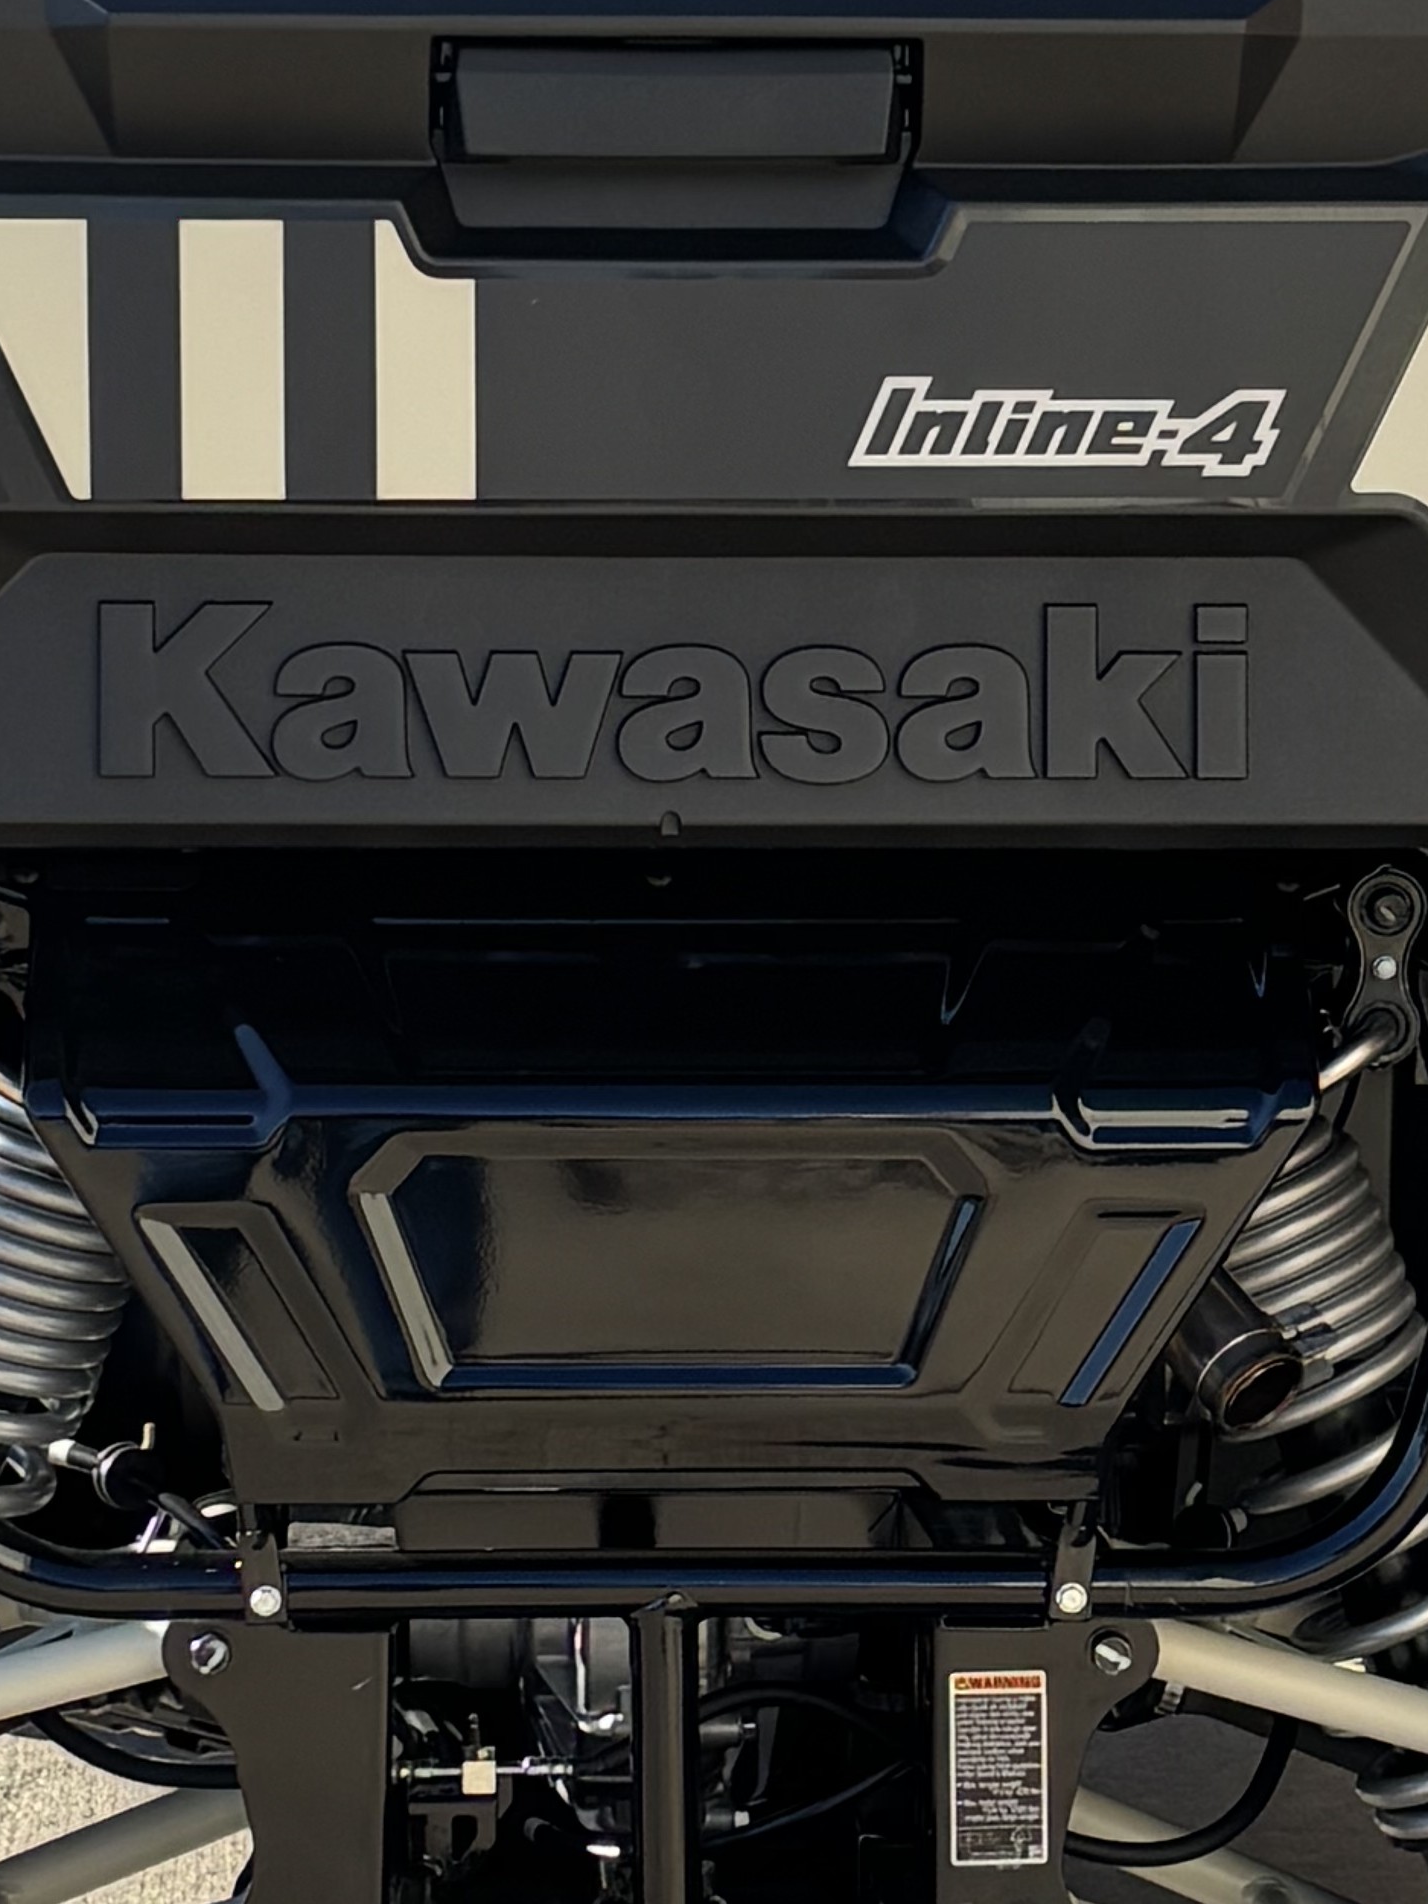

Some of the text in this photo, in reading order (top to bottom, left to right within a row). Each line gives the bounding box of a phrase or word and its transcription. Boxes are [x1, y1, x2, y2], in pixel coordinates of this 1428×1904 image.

[848, 376, 1287, 477] Inline-4
[97, 599, 1249, 786] Kawasaki
[969, 1675, 1041, 1690] WARNING
